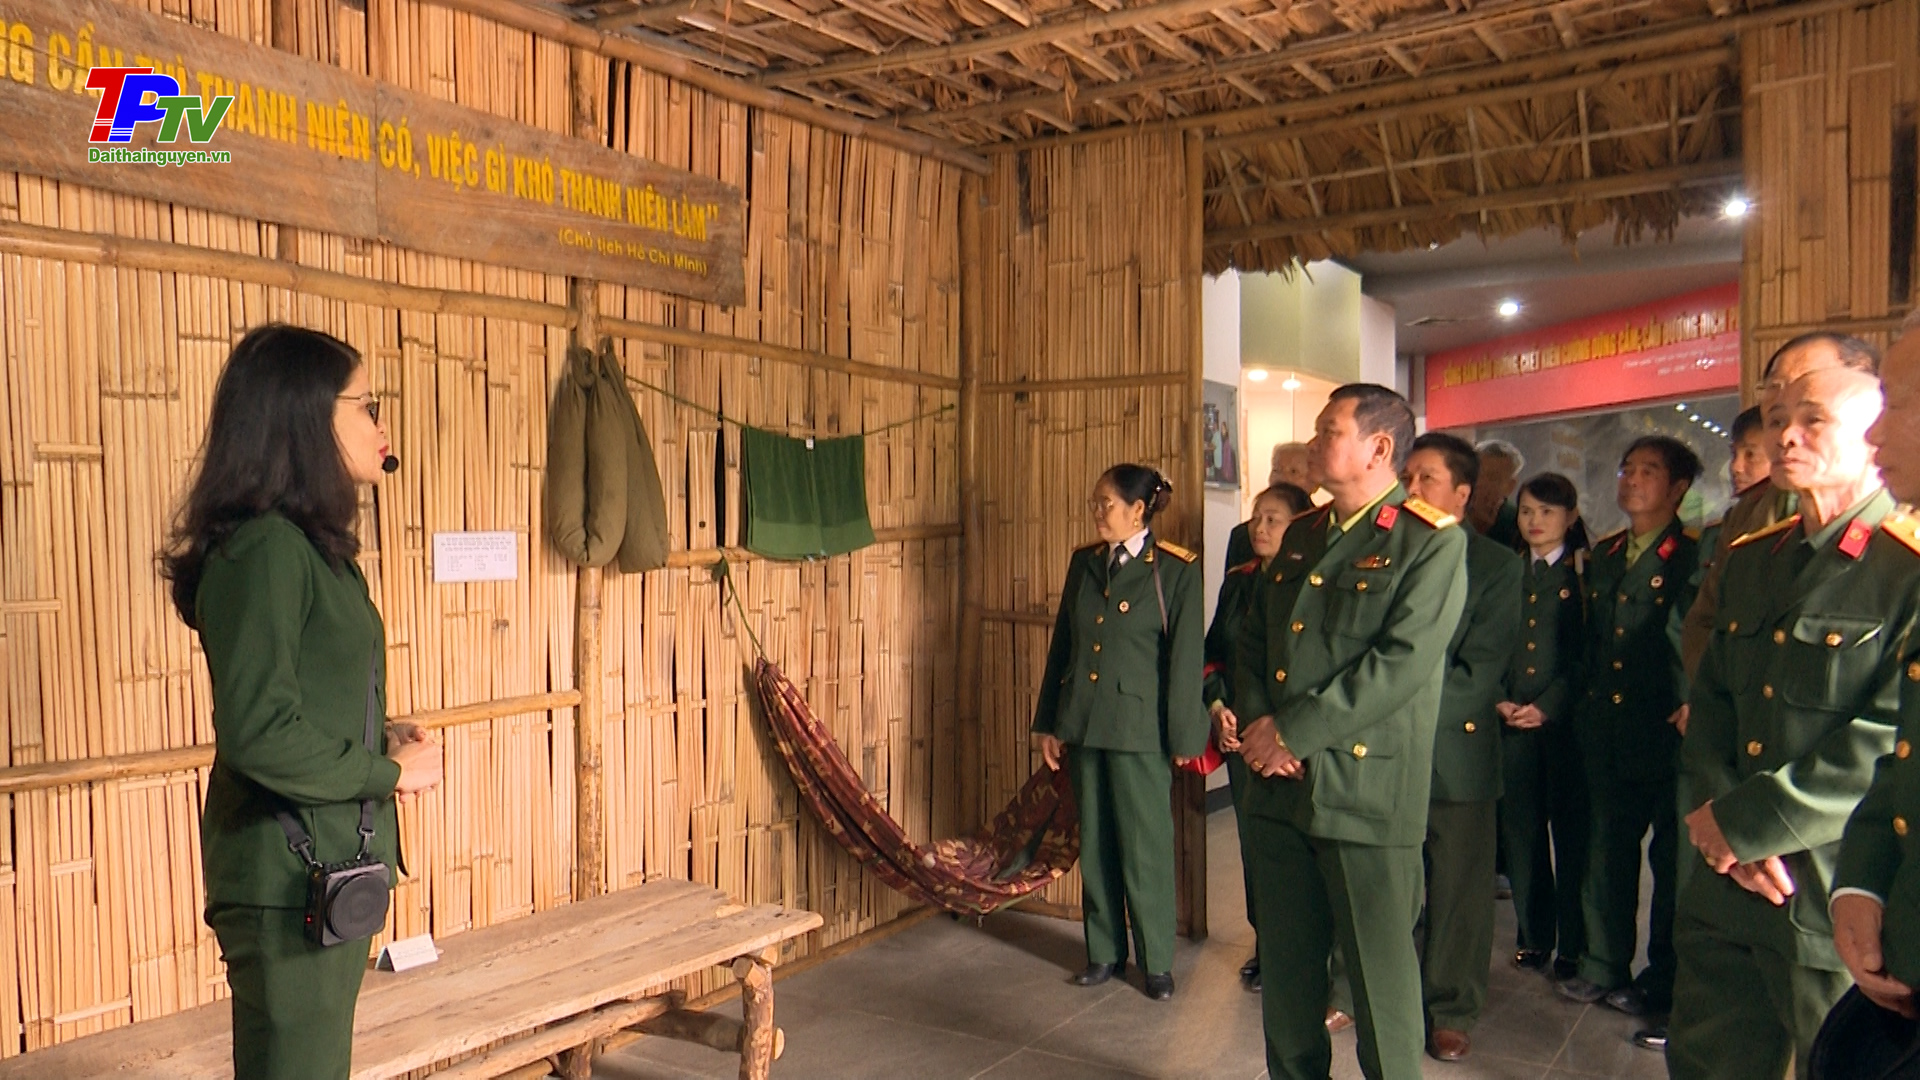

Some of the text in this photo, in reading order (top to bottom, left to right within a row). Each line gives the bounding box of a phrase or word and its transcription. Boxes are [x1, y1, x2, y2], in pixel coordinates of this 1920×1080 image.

[196, 71, 297, 144] THANH
[306, 99, 371, 162] NIÊN
[379, 116, 420, 179] CÓ,
[427, 131, 479, 193] VIỆC
[485, 143, 507, 194] GÌ
[513, 156, 555, 206] KHÓ
[560, 169, 623, 221] THANH
[626, 183, 669, 233] NIÊN
